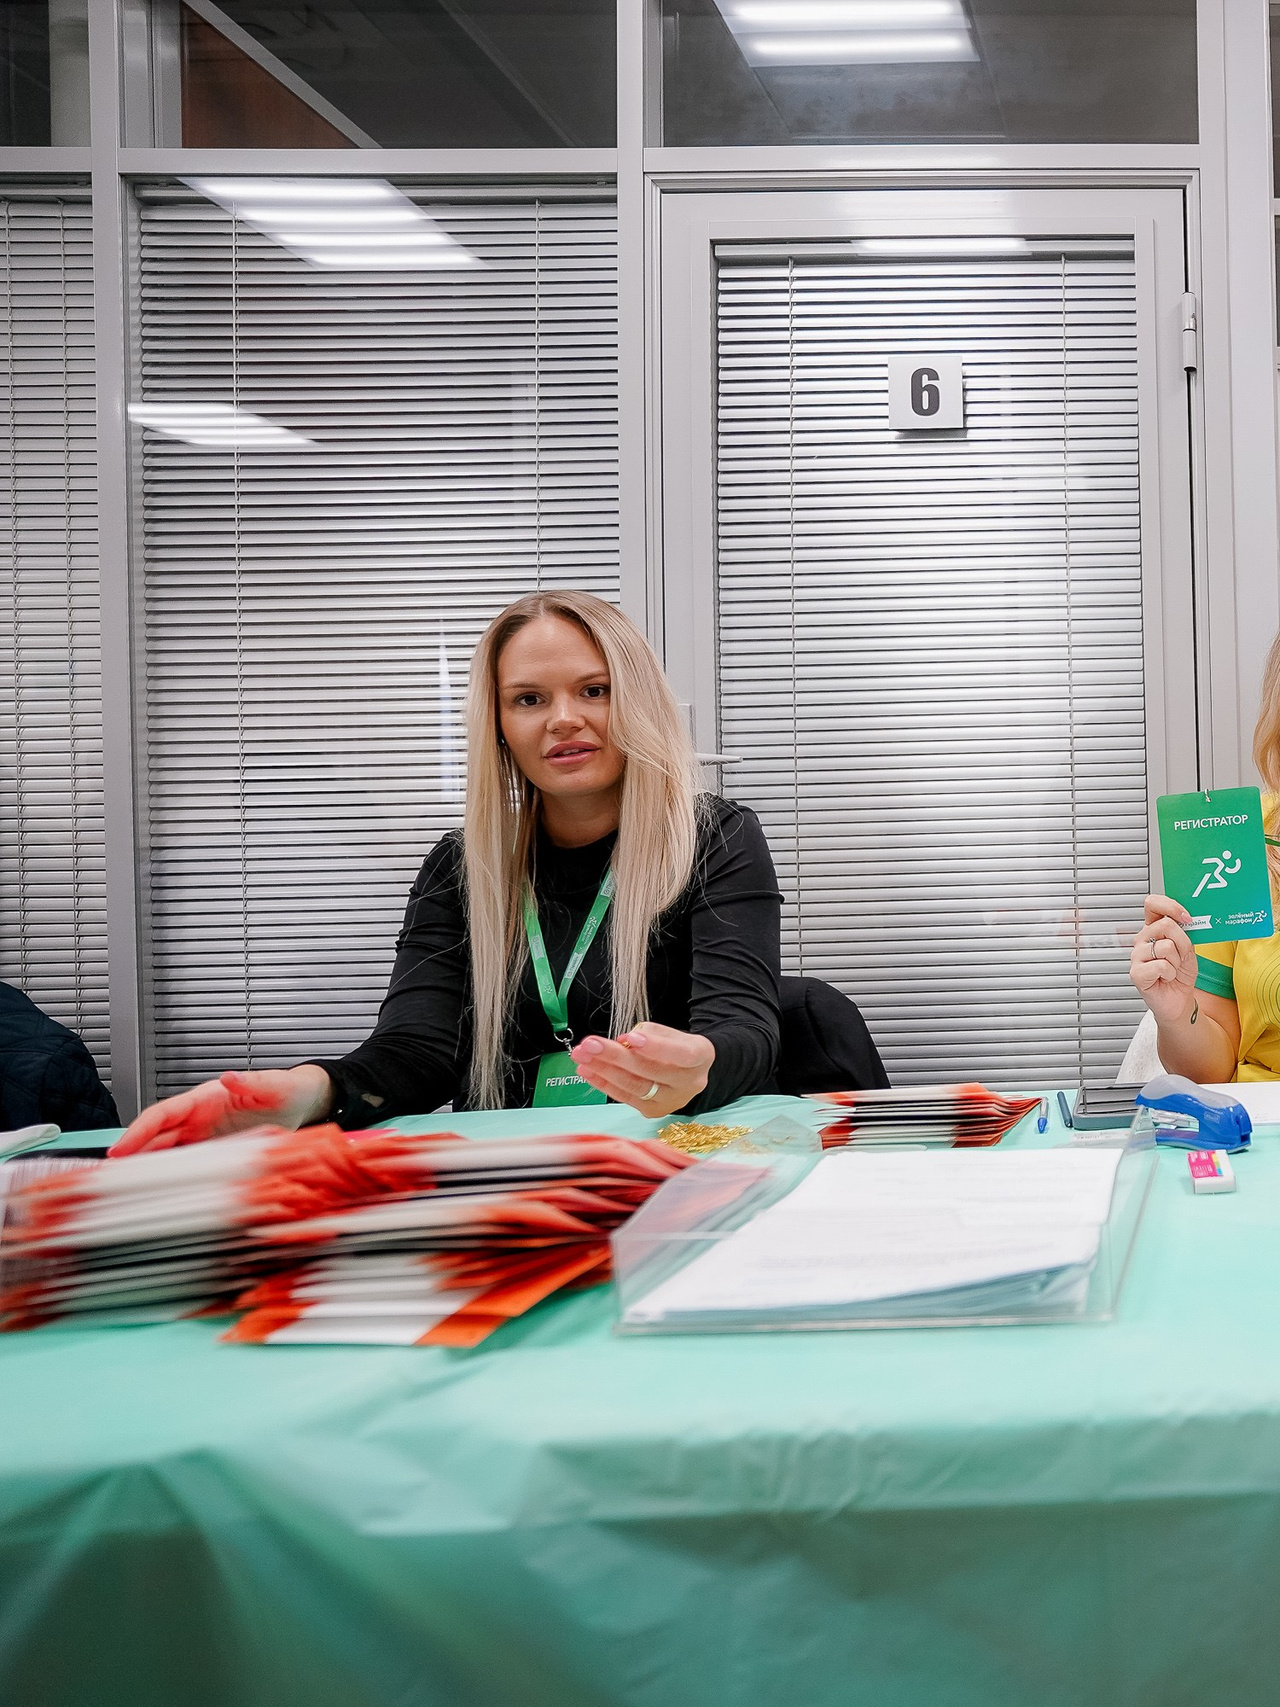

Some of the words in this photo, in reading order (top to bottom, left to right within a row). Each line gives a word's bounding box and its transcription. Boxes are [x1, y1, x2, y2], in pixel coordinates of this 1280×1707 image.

[911, 367, 940, 416] 6
[1174, 814, 1249, 831] РЕГИСТРАТОР
[545, 1075, 587, 1087] РЕГИСТРА
